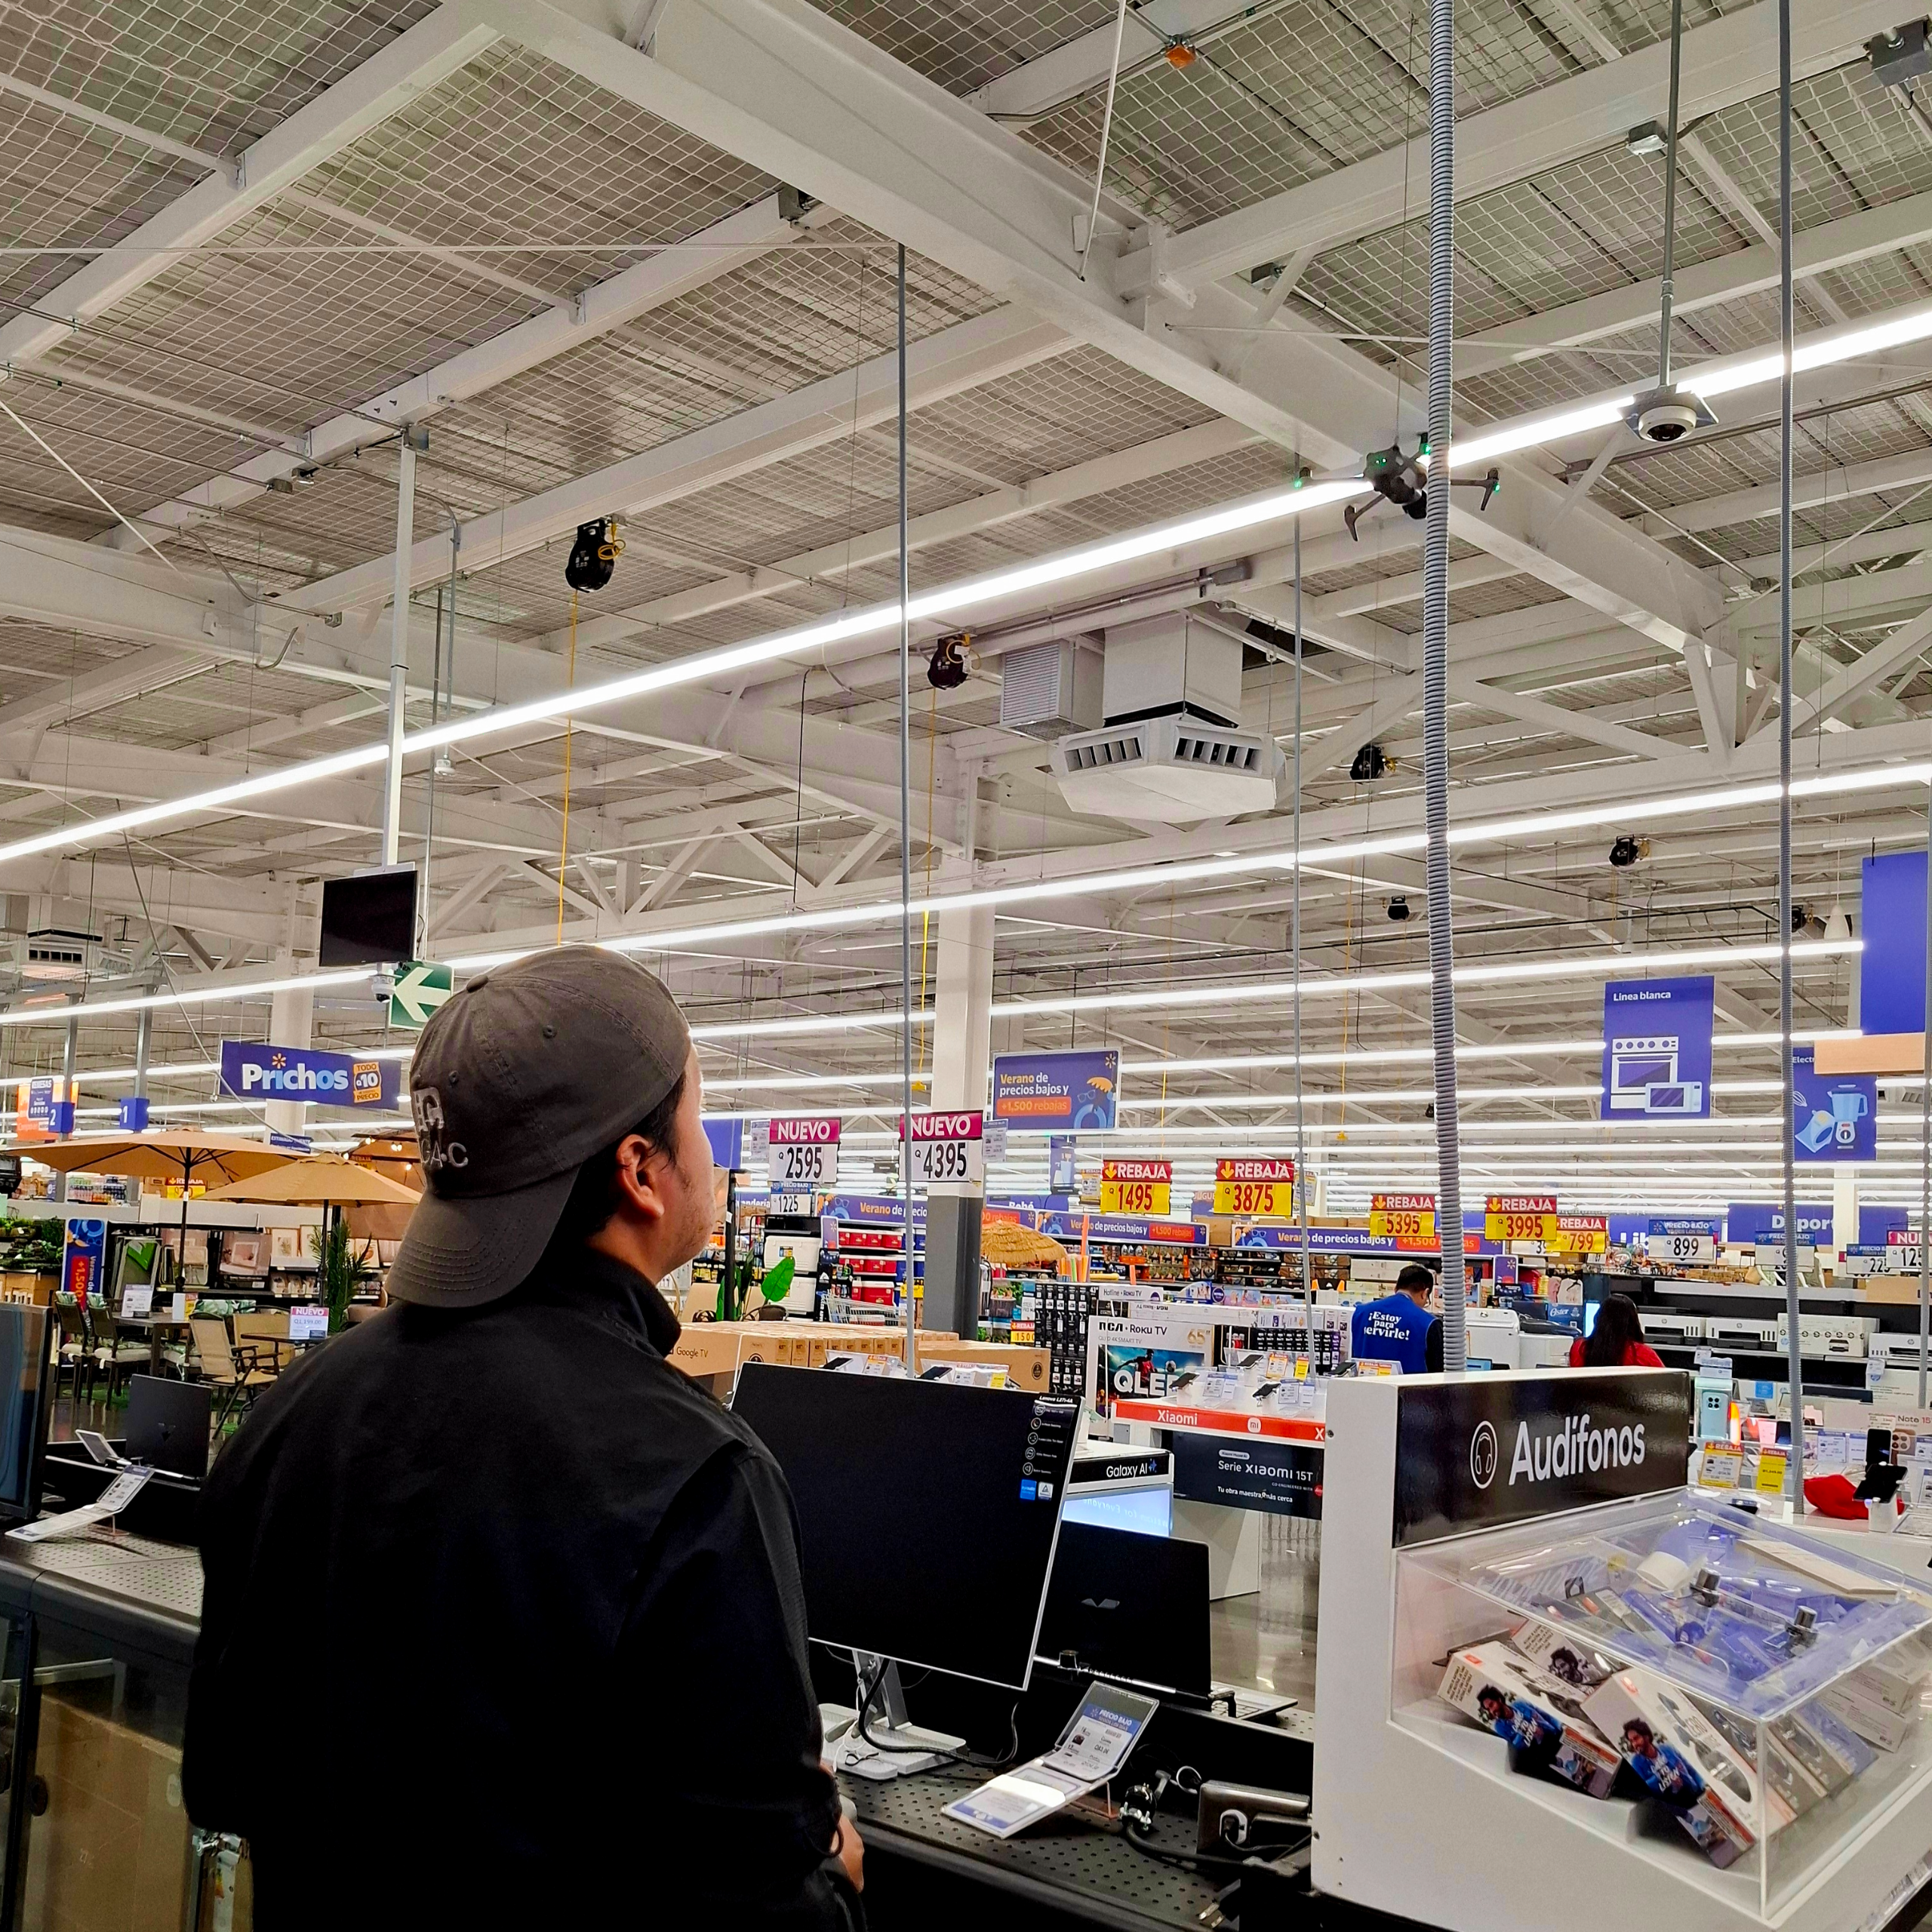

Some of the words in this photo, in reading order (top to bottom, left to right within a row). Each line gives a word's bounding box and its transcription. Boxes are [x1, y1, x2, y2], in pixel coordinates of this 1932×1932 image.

[1640, 990, 1671, 1000] blanca
[356, 1063, 377, 1072] TODO
[242, 1063, 349, 1090] Prichos
[1000, 1074, 1035, 1084] Verano
[1035, 1072, 1048, 1083] de
[357, 1093, 380, 1101] PRECIO
[999, 1085, 1035, 1097] precios
[1035, 1084, 1061, 1096] bajos
[1063, 1084, 1069, 1095] y
[1001, 1100, 1032, 1111] +1,500
[1034, 1100, 1067, 1111] rebajas
[50, 1109, 57, 1126] 2
[122, 1106, 129, 1123] 1
[777, 1121, 830, 1140] NUEVO
[911, 1115, 971, 1137] NUEVO
[786, 1146, 823, 1179] 2595
[924, 1142, 967, 1179] 4395
[1118, 1164, 1168, 1179] REBAJA
[1234, 1163, 1290, 1179] REBAJA
[778, 1195, 798, 1213] 1225
[1117, 1183, 1153, 1211] 1495
[1232, 1183, 1274, 1212] 3875
[1386, 1196, 1432, 1209] REBAJA
[1501, 1198, 1553, 1211] REBAJA
[860, 1202, 891, 1214] Verano
[892, 1206, 903, 1215] de
[1095, 1221, 1103, 1230] de
[1104, 1223, 1125, 1233] precios
[1127, 1223, 1142, 1234] bajos
[1143, 1226, 1147, 1235] y
[1386, 1213, 1422, 1234] 5395
[1506, 1215, 1543, 1238] 3995
[1559, 1218, 1602, 1229] REBAJA
[1664, 1220, 1690, 1229] PRECIO
[1312, 1232, 1323, 1243] de
[1325, 1234, 1359, 1245] precios
[1360, 1234, 1386, 1246] bajos
[1387, 1237, 1393, 1247] y
[1569, 1232, 1594, 1251] 799
[1673, 1237, 1699, 1257] 899
[88, 1256, 97, 1281] Verano
[88, 1281, 95, 1291] de
[1368, 1311, 1401, 1324] ¡Estoy
[1099, 1322, 1123, 1332] RCA
[1155, 1326, 1168, 1335] TV
[1374, 1321, 1394, 1330] para
[676, 1346, 698, 1358] Google
[700, 1349, 708, 1358] TV
[1157, 1409, 1198, 1426] Xiaomi
[1897, 1415, 1919, 1423] Note
[1508, 1414, 1645, 1486] Audífonos
[1715, 1443, 1742, 1452] REBAJA
[1106, 1465, 1138, 1478] Galaxy
[1218, 1460, 1242, 1472] Serie
[1296, 1471, 1313, 1481] 15T
[1226, 1487, 1238, 1495] obra
[1099, 1709, 1118, 1721] PRECIO
[1118, 1715, 1133, 1726] BAJO
